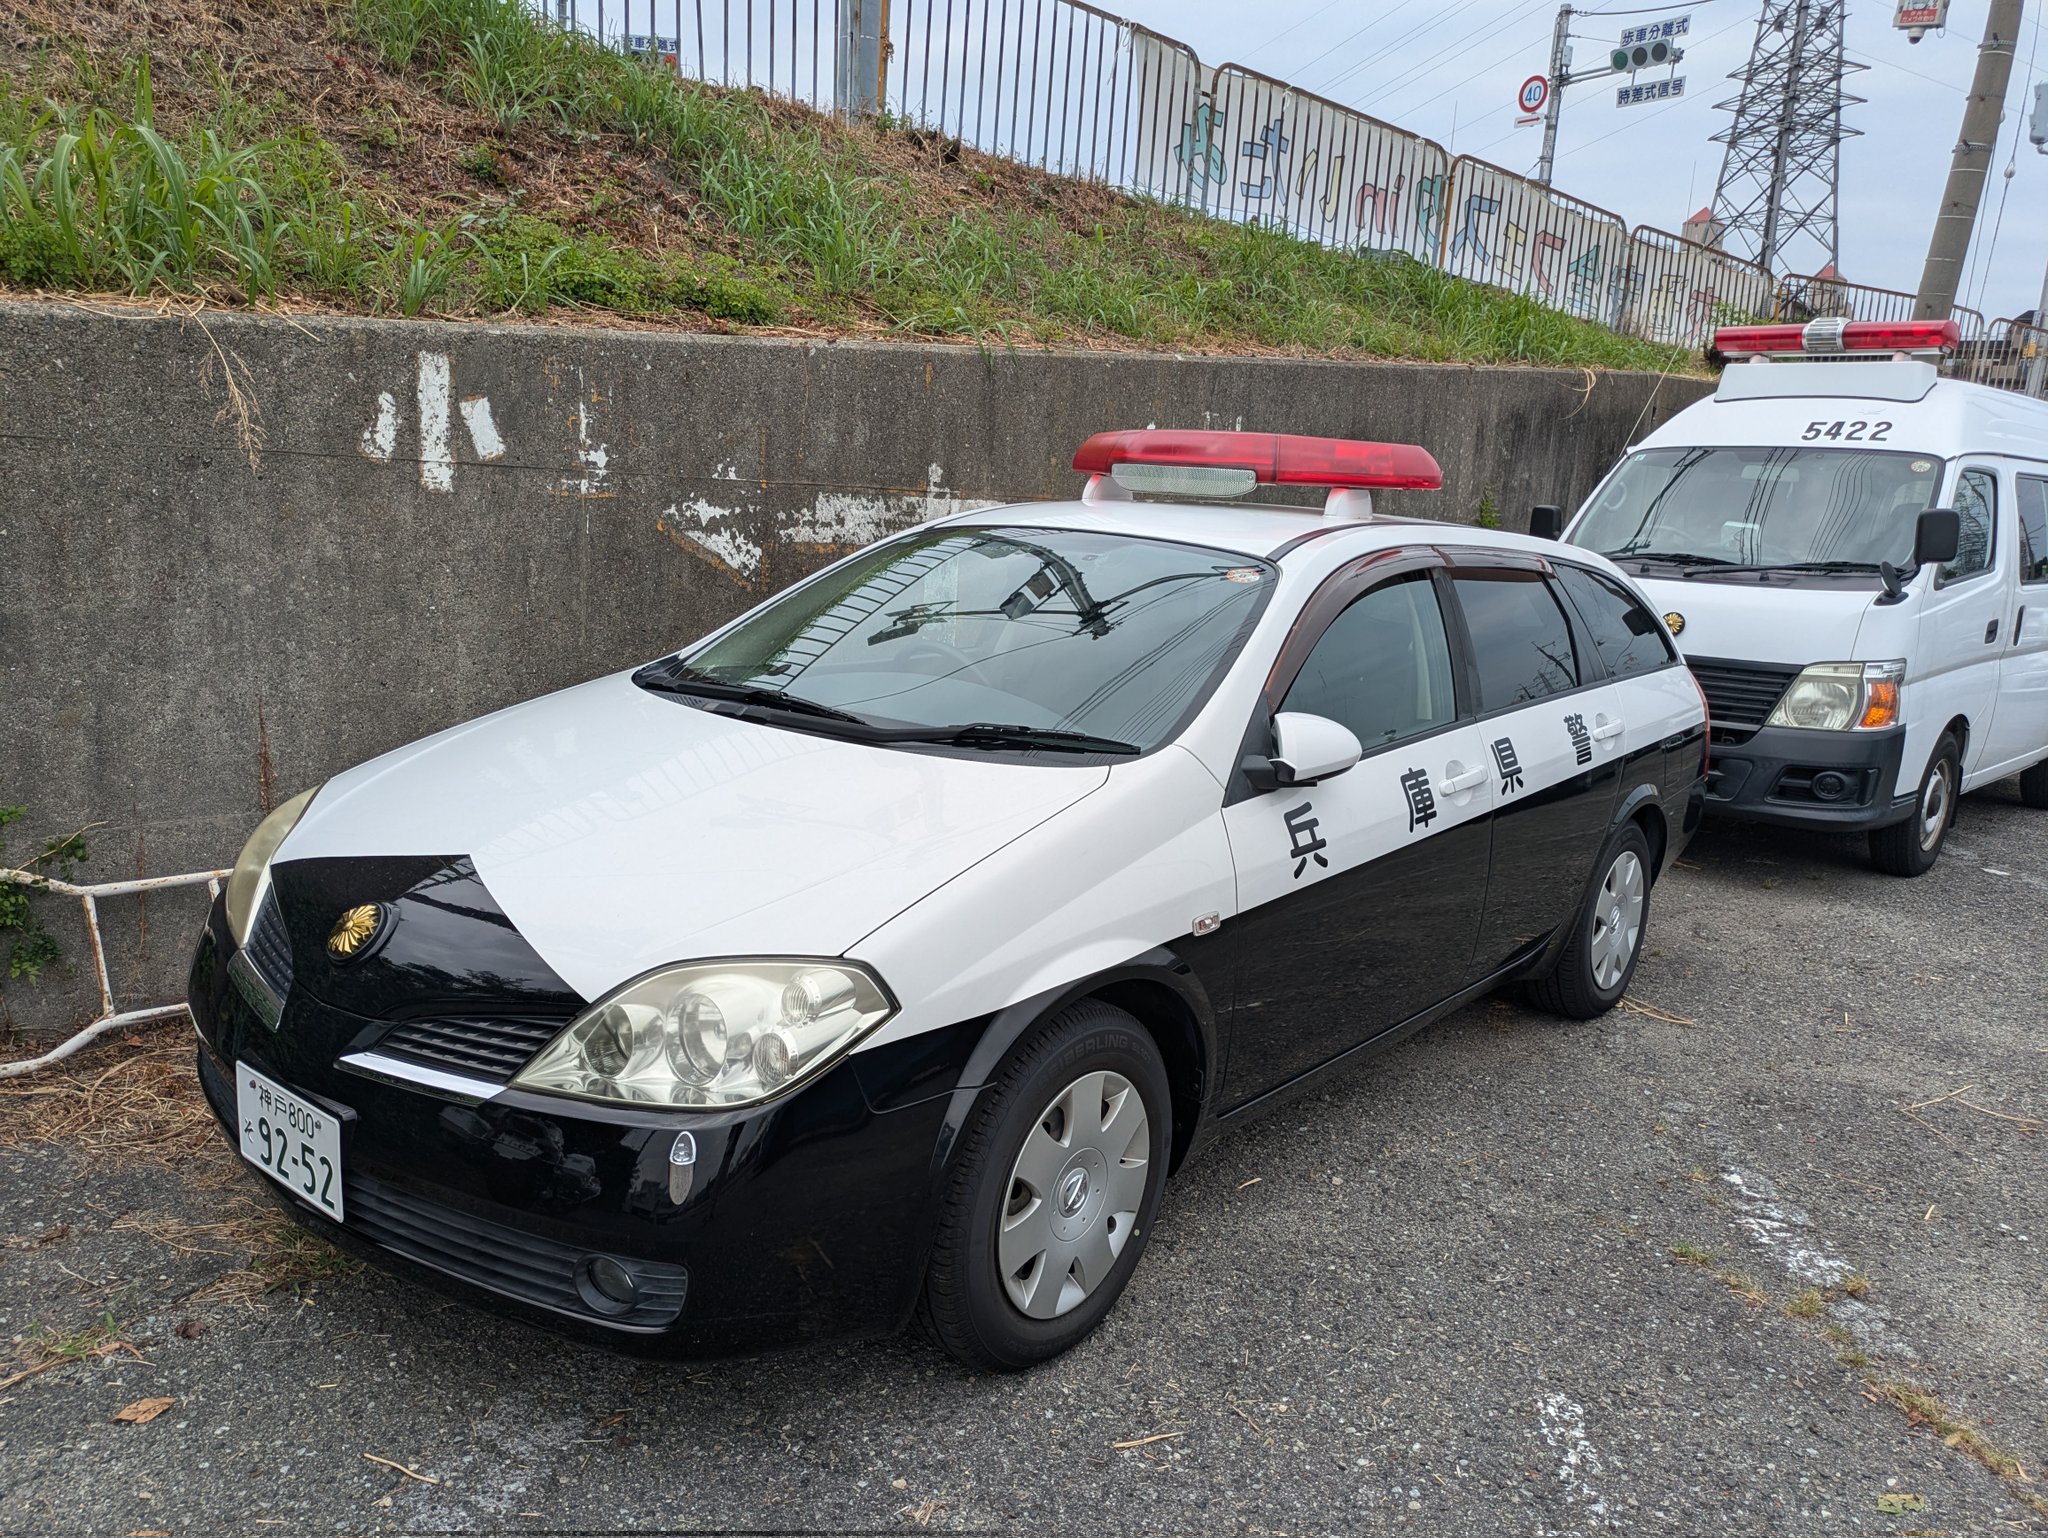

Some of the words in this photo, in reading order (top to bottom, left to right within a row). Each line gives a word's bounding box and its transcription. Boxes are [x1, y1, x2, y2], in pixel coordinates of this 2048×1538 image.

[1621, 17, 1688, 47] 歩車分離式
[1525, 85, 1541, 102] 40
[1618, 79, 1683, 104] 時差式信号
[1801, 420, 1893, 442] 5422
[1039, 1033, 1129, 1088] EIBERLING
[244, 1118, 255, 1144] そ
[258, 1116, 335, 1211] 92-52
